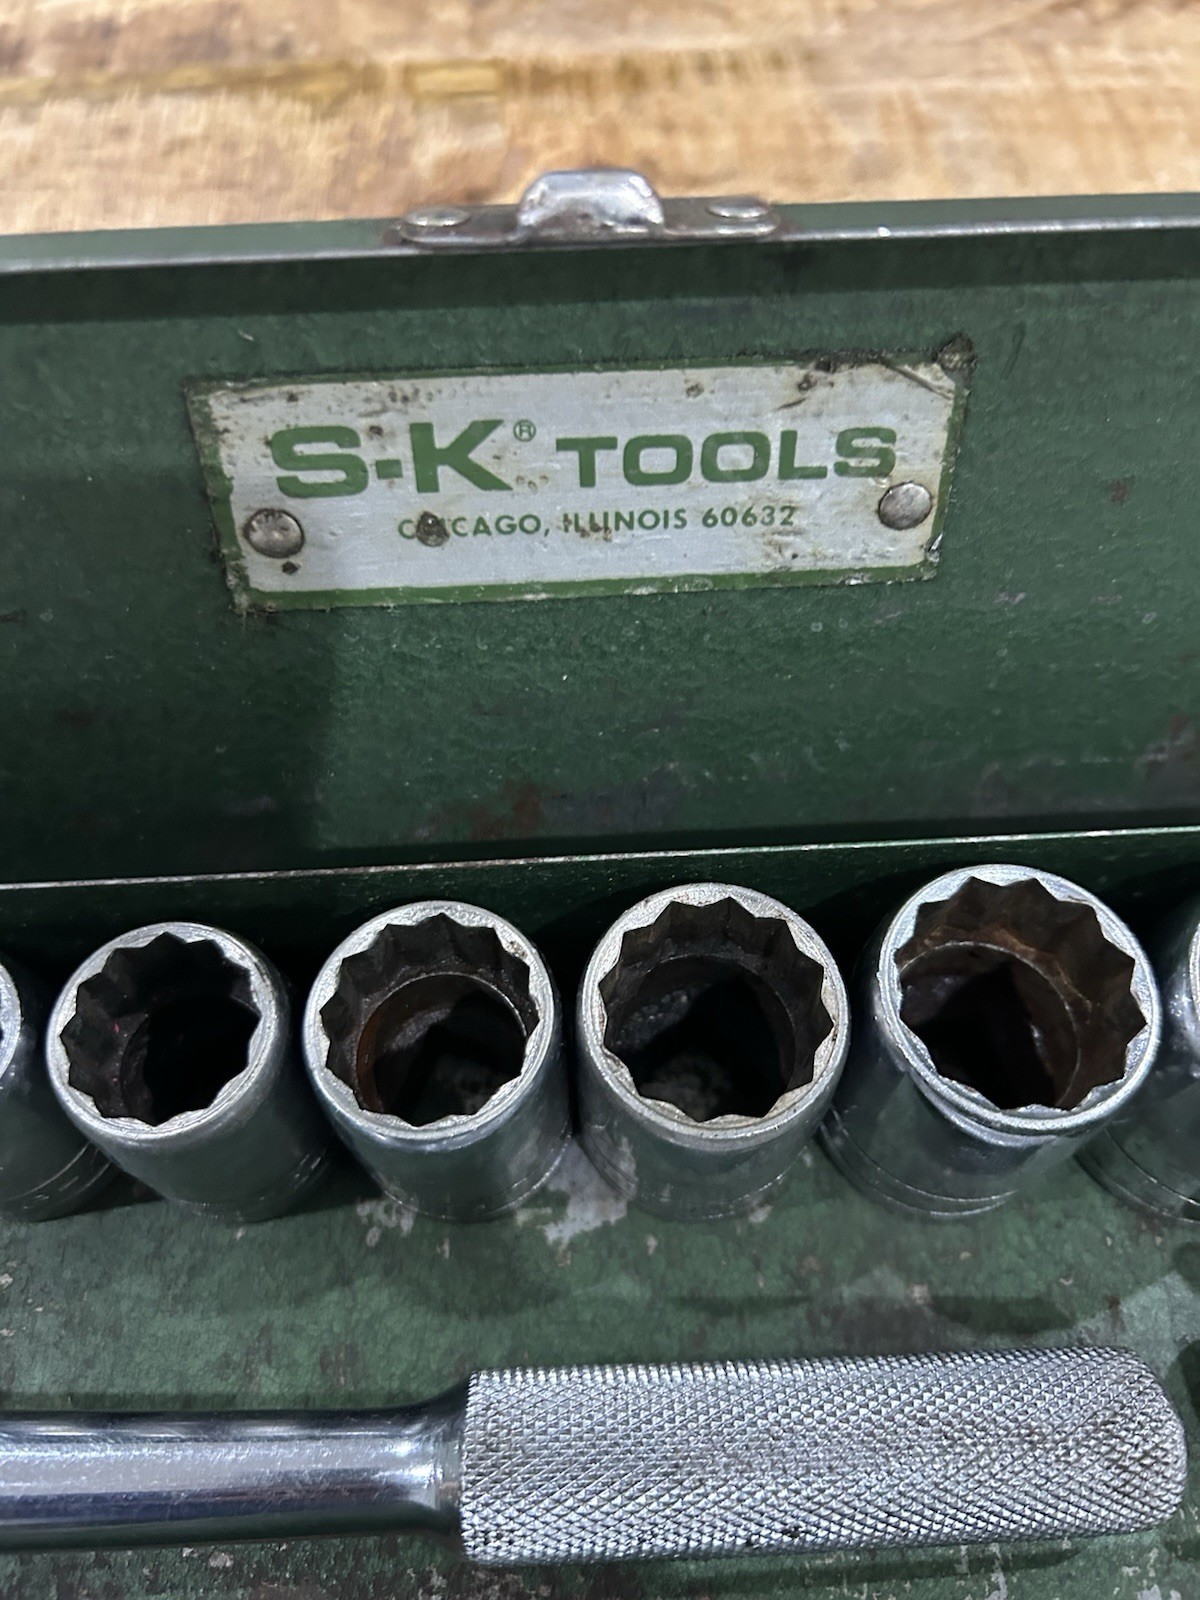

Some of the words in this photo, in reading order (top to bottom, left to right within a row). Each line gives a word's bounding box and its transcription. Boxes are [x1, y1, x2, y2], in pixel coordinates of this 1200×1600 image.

[556, 427, 897, 488] TOOLS
[398, 512, 550, 539] CCAGO,
[563, 508, 688, 533] ILLINOIS
[702, 504, 797, 529] 60632
